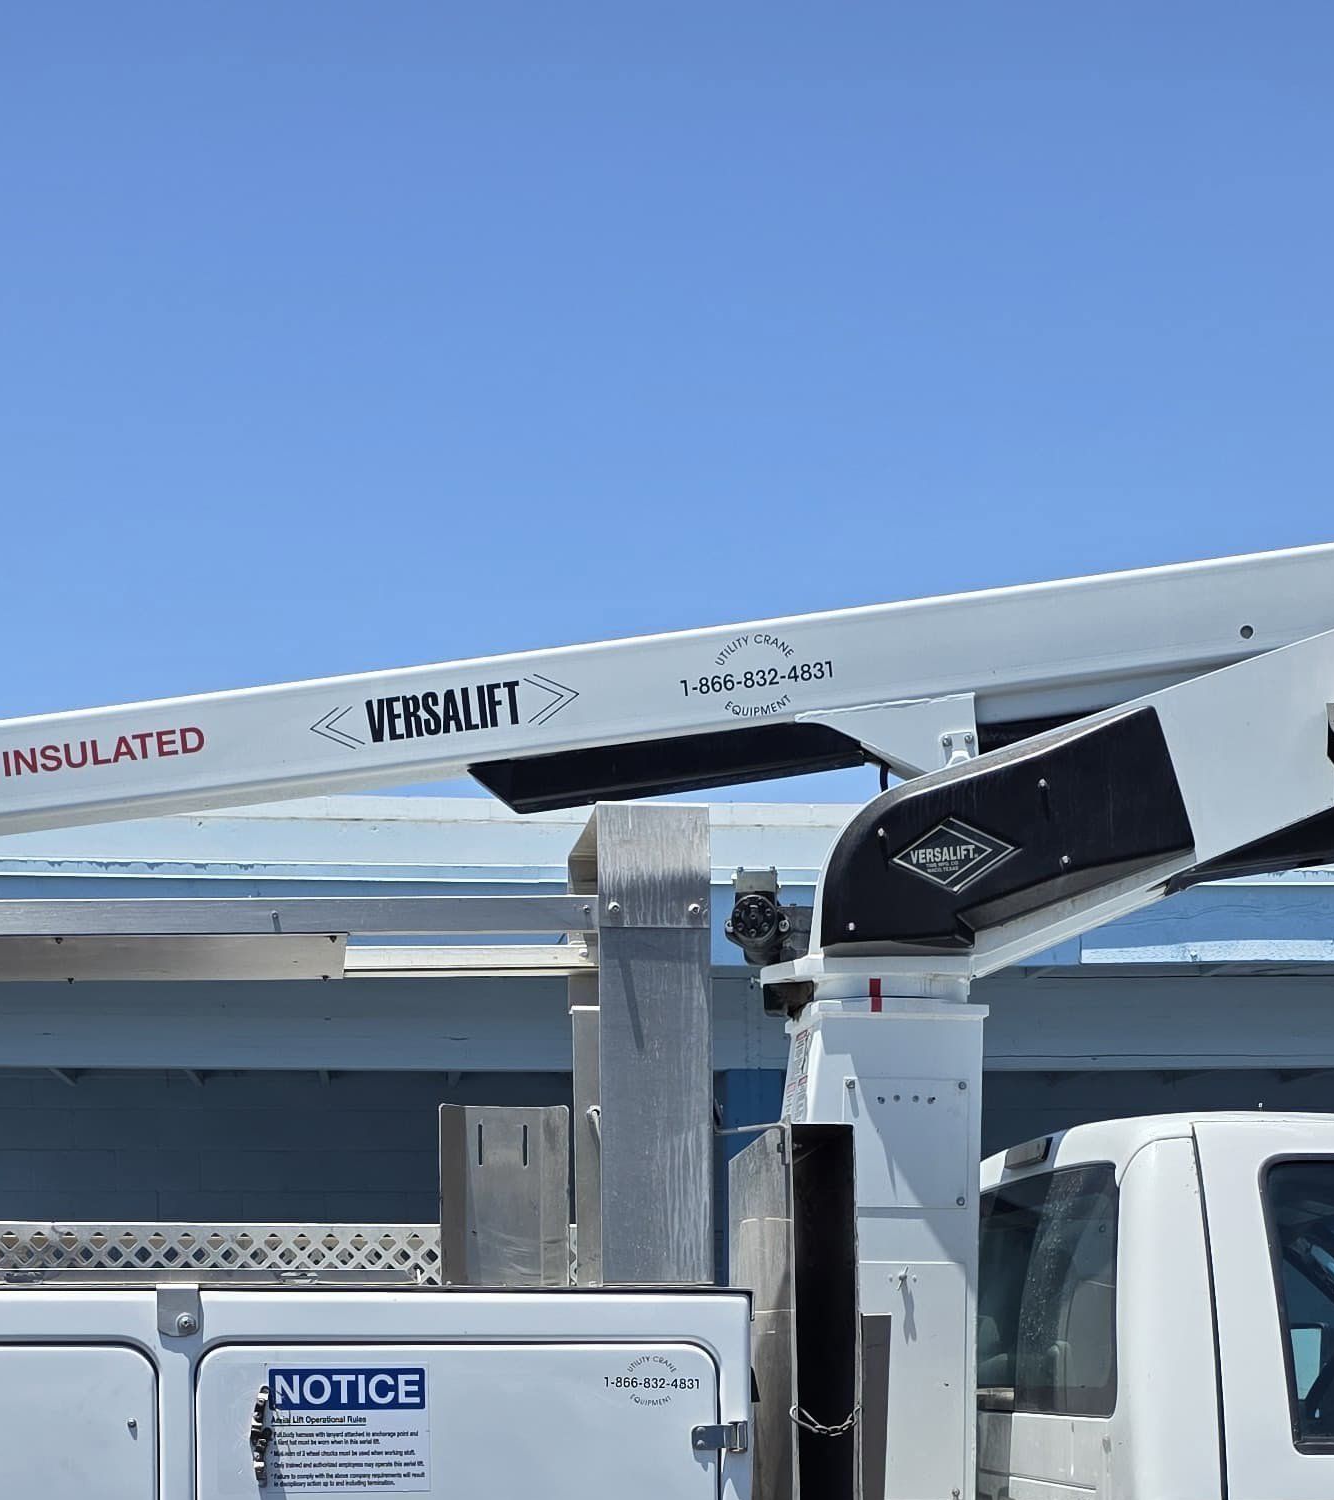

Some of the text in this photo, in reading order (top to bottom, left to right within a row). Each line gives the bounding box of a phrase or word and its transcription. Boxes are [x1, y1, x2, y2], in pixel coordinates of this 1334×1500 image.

[714, 634, 795, 666] UTILITY CRANE
[680, 660, 834, 696] 1-866-832-4831
[365, 680, 520, 743] VERSALIFT
[725, 694, 791, 717] EQUIPMENT
[2, 727, 205, 777] INSULATED
[910, 845, 975, 865] VERSALIFT
[627, 1355, 677, 1373] UTILITY CRANE
[274, 1374, 421, 1405] NOTICE
[604, 1376, 700, 1390] 1-866-832-4831
[630, 1394, 671, 1406] EQUIPMENT
[292, 1415, 304, 1423] Lift
[305, 1415, 346, 1424] Operational
[347, 1415, 367, 1423] Rules
